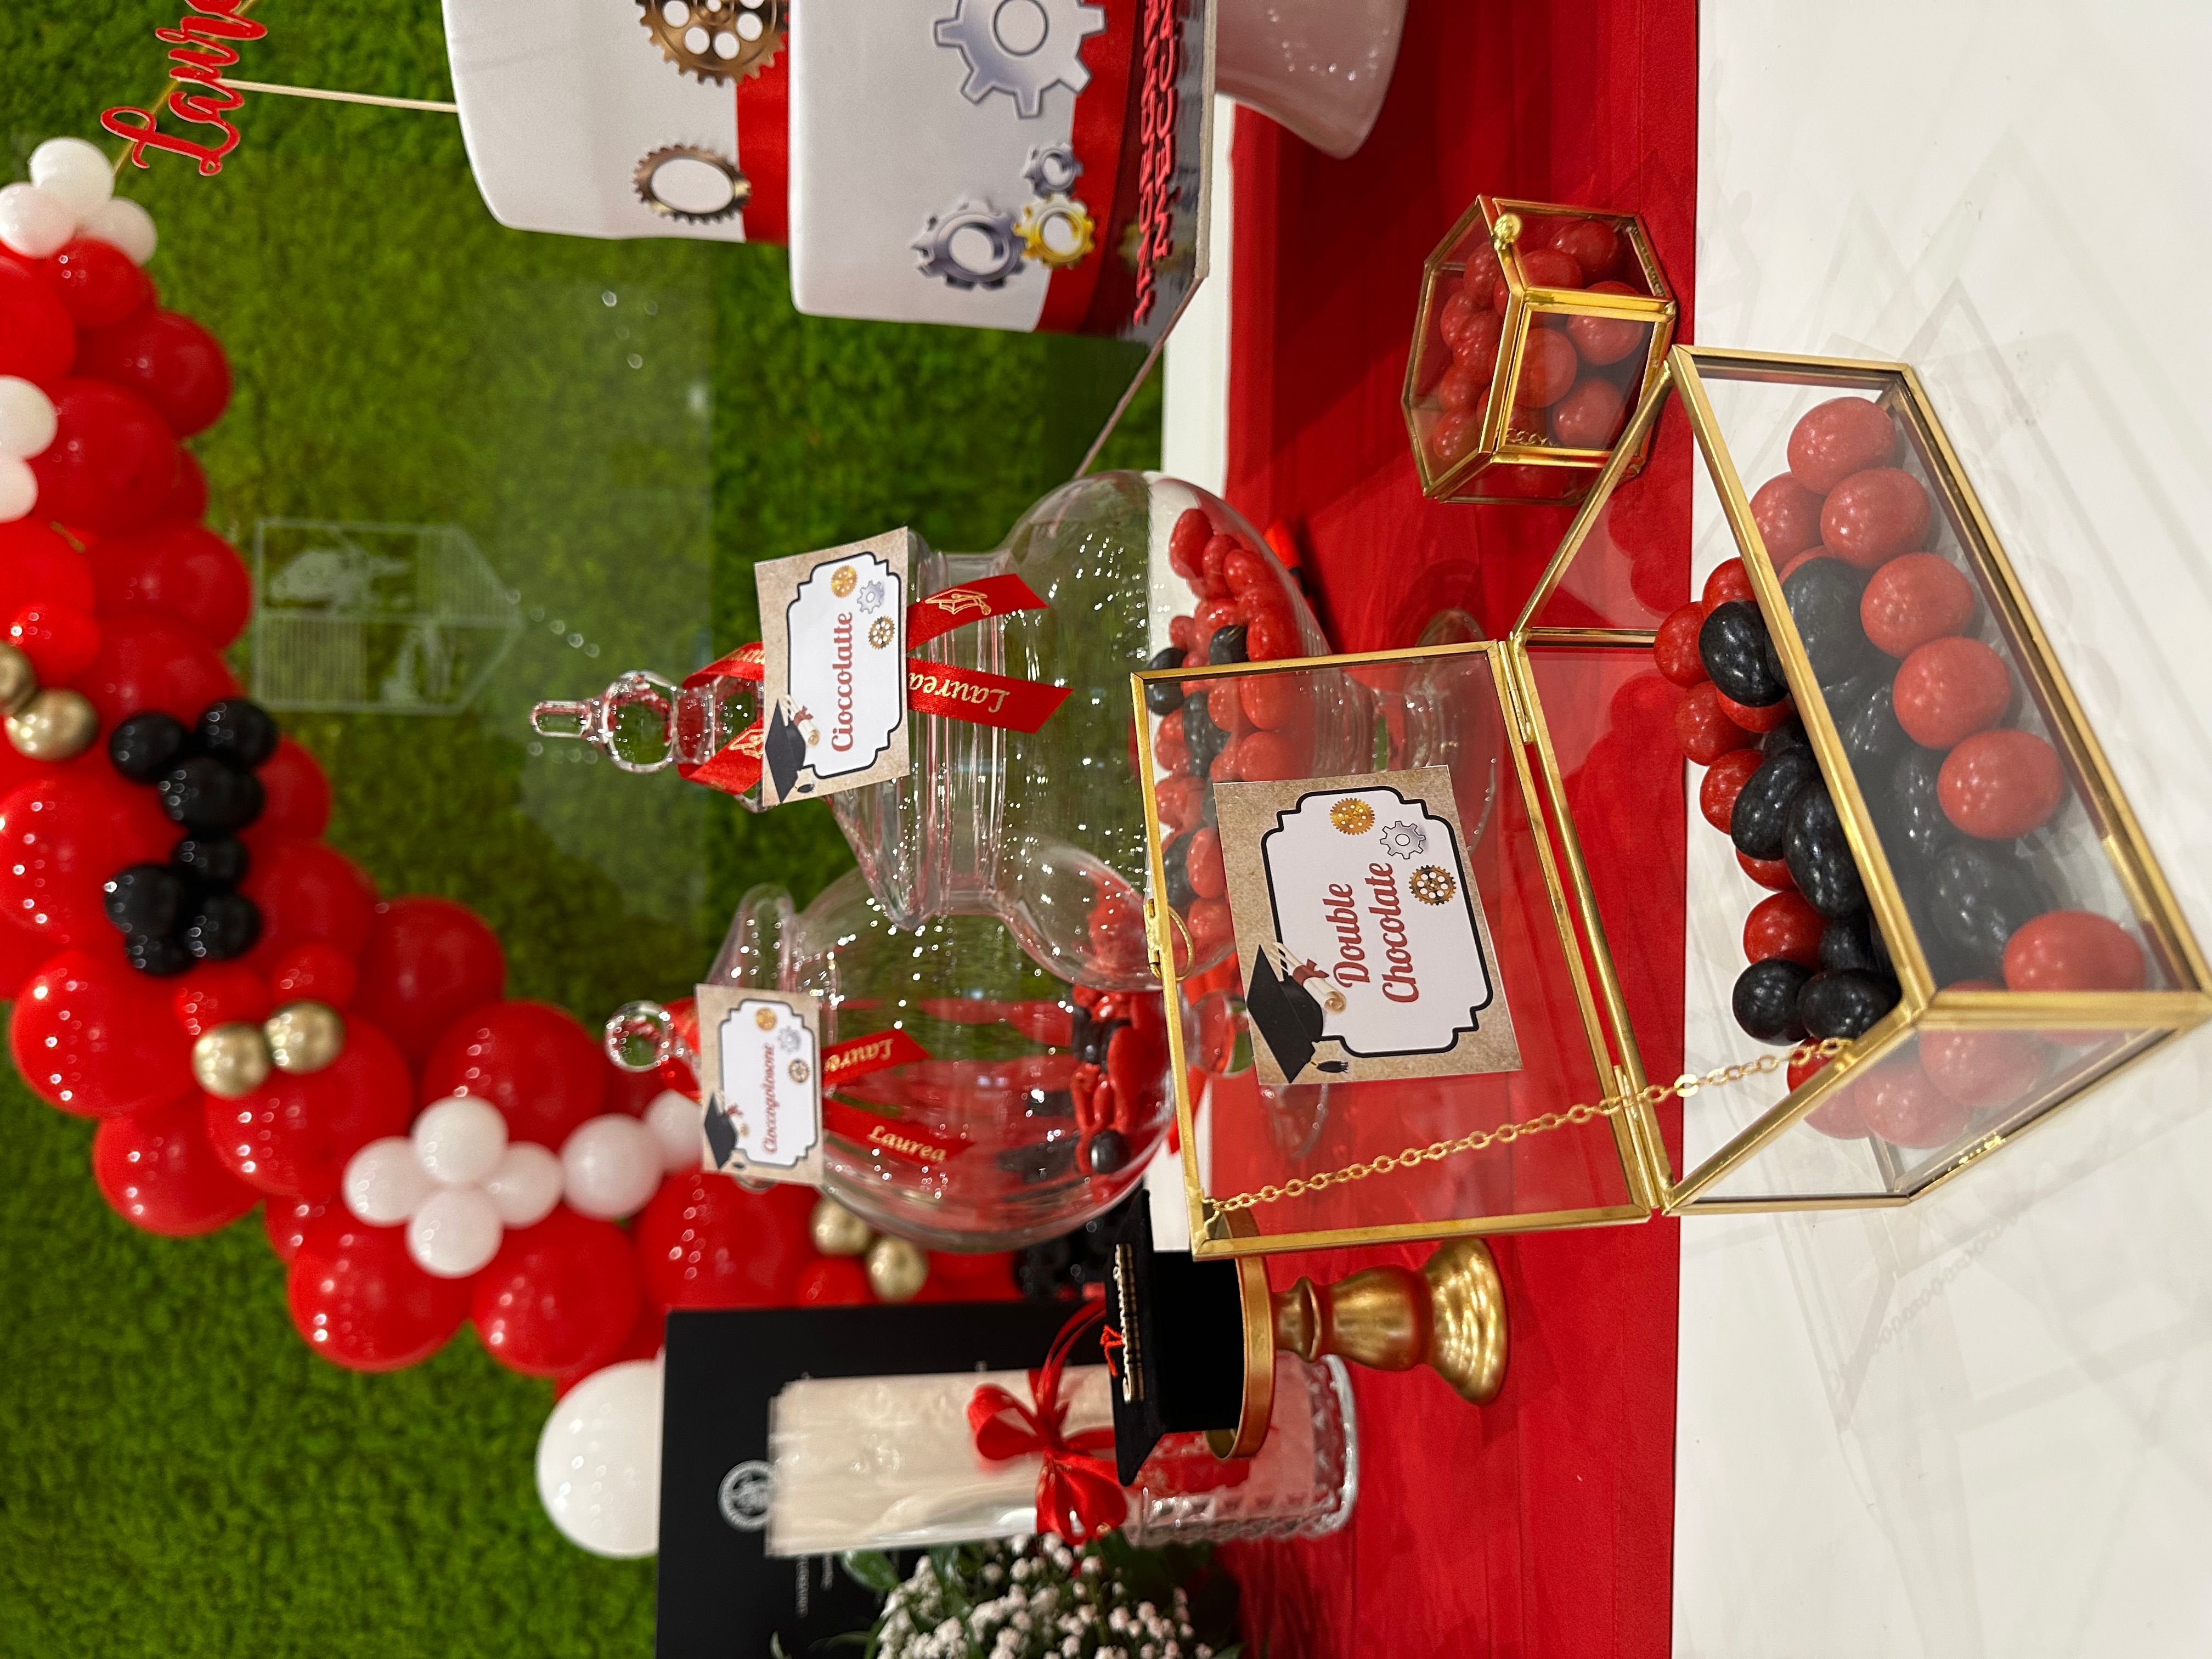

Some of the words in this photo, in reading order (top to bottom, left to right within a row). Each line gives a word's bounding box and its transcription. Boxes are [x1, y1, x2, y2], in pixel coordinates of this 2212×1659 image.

[831, 611, 854, 752] Cioccolatte
[908, 673, 1010, 713] Laurea
[1322, 883, 1370, 988] Double
[1364, 862, 1419, 1002] Chocolate
[761, 1042, 780, 1155] Cioccogolosone
[867, 1125, 946, 1164] Laurea
